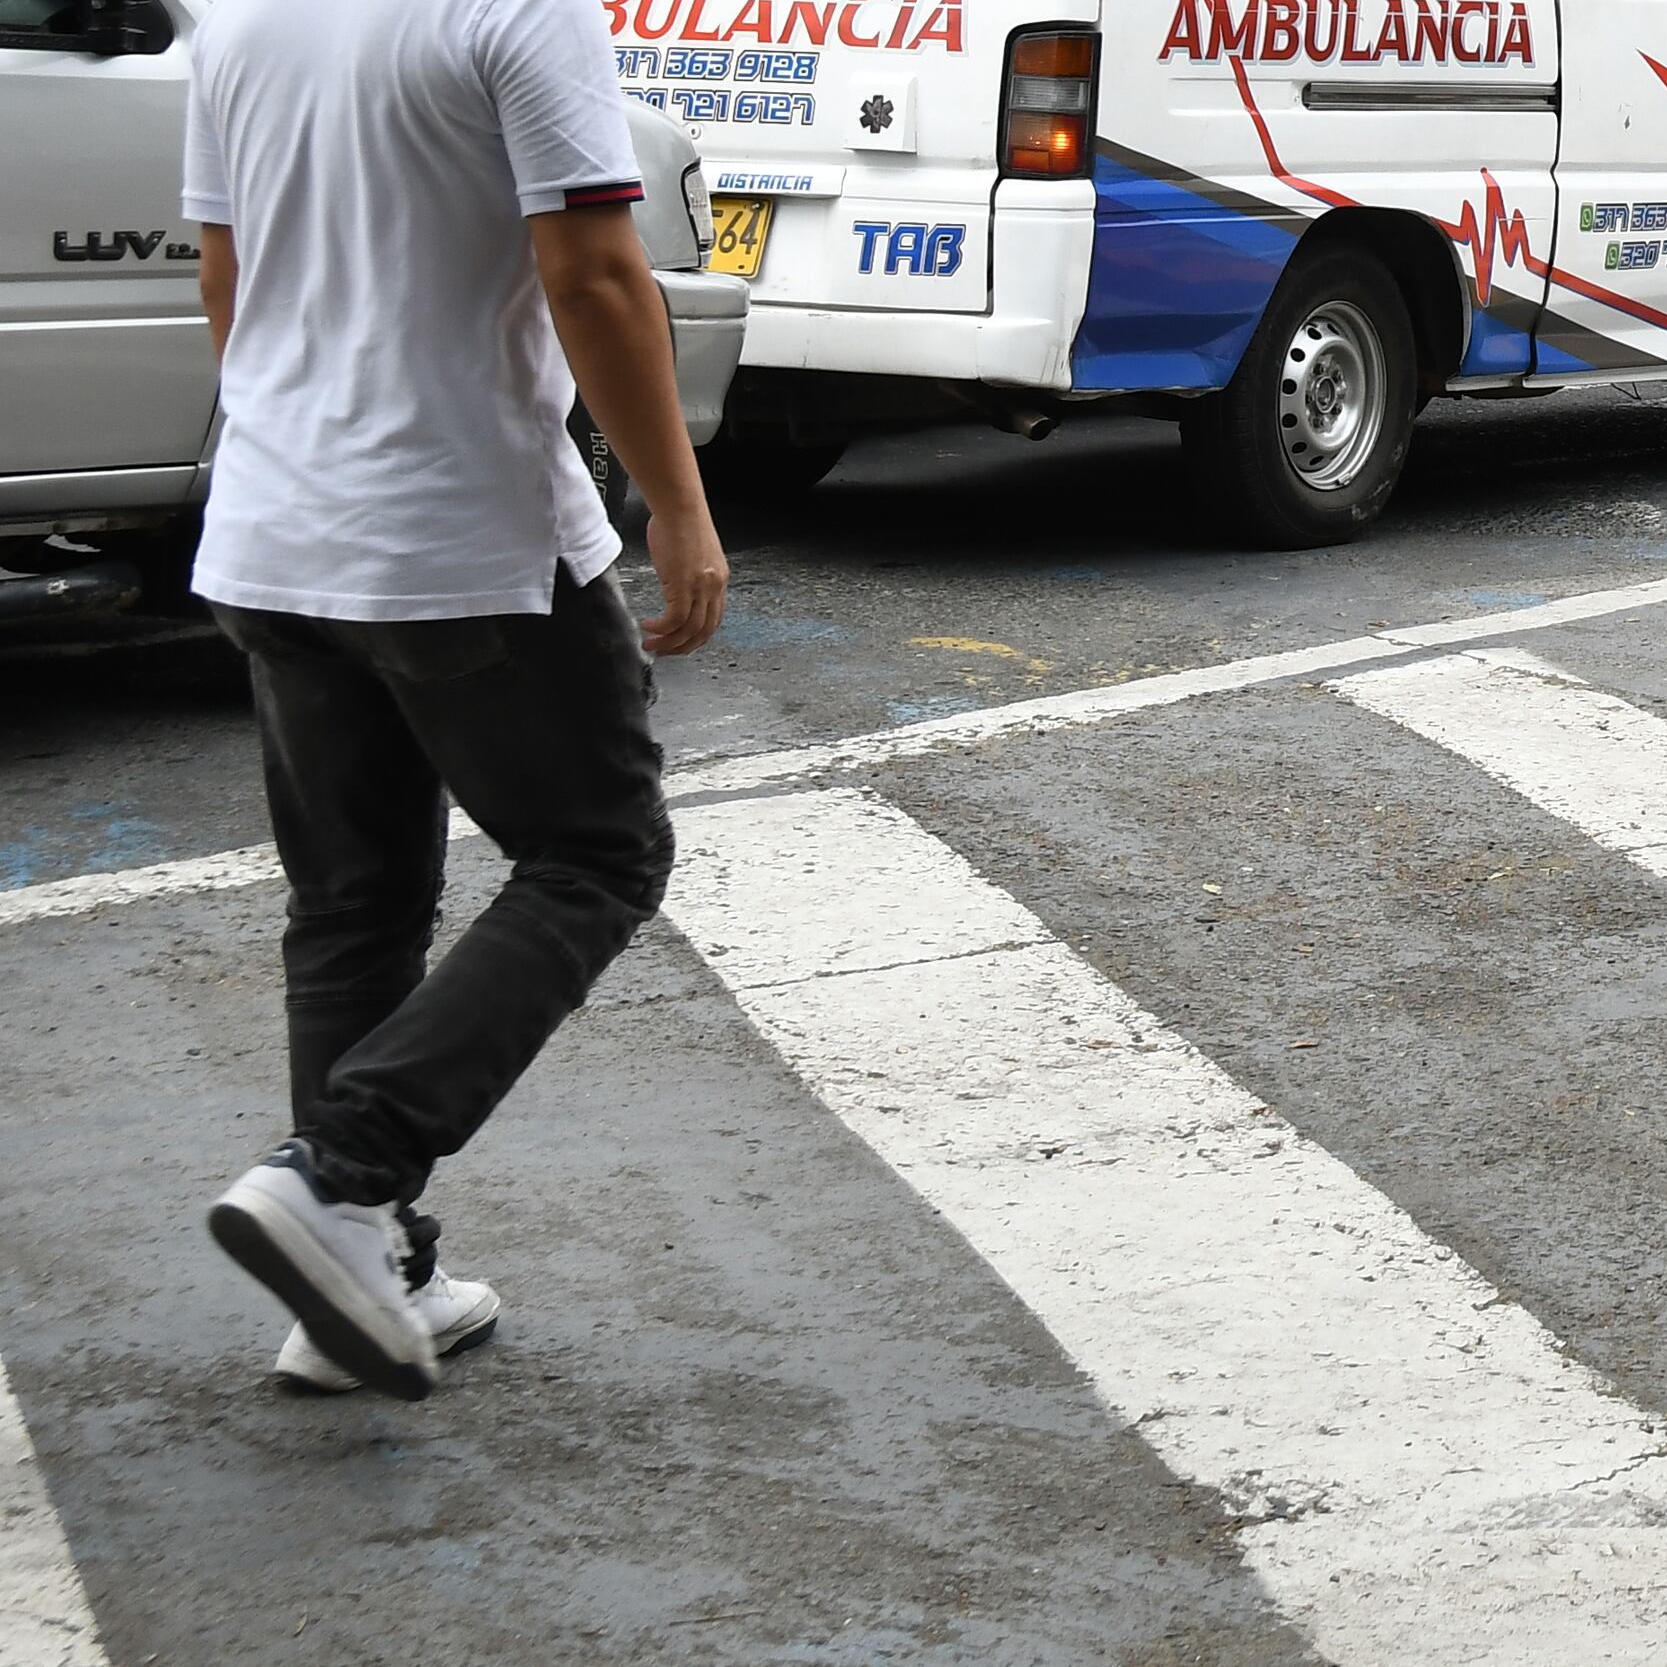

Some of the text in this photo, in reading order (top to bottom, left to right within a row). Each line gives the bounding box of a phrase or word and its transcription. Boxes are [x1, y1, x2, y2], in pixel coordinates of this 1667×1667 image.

[663, 47, 734, 81] 363
[734, 50, 820, 84] 9128
[672, 89, 731, 122] 721
[733, 91, 816, 125] 6127
[717, 173, 813, 191] DISTANCIA
[1593, 203, 1630, 232] 317
[54, 230, 167, 261] LUV
[853, 221, 967, 276] TAB
[1618, 241, 1661, 270] 320
